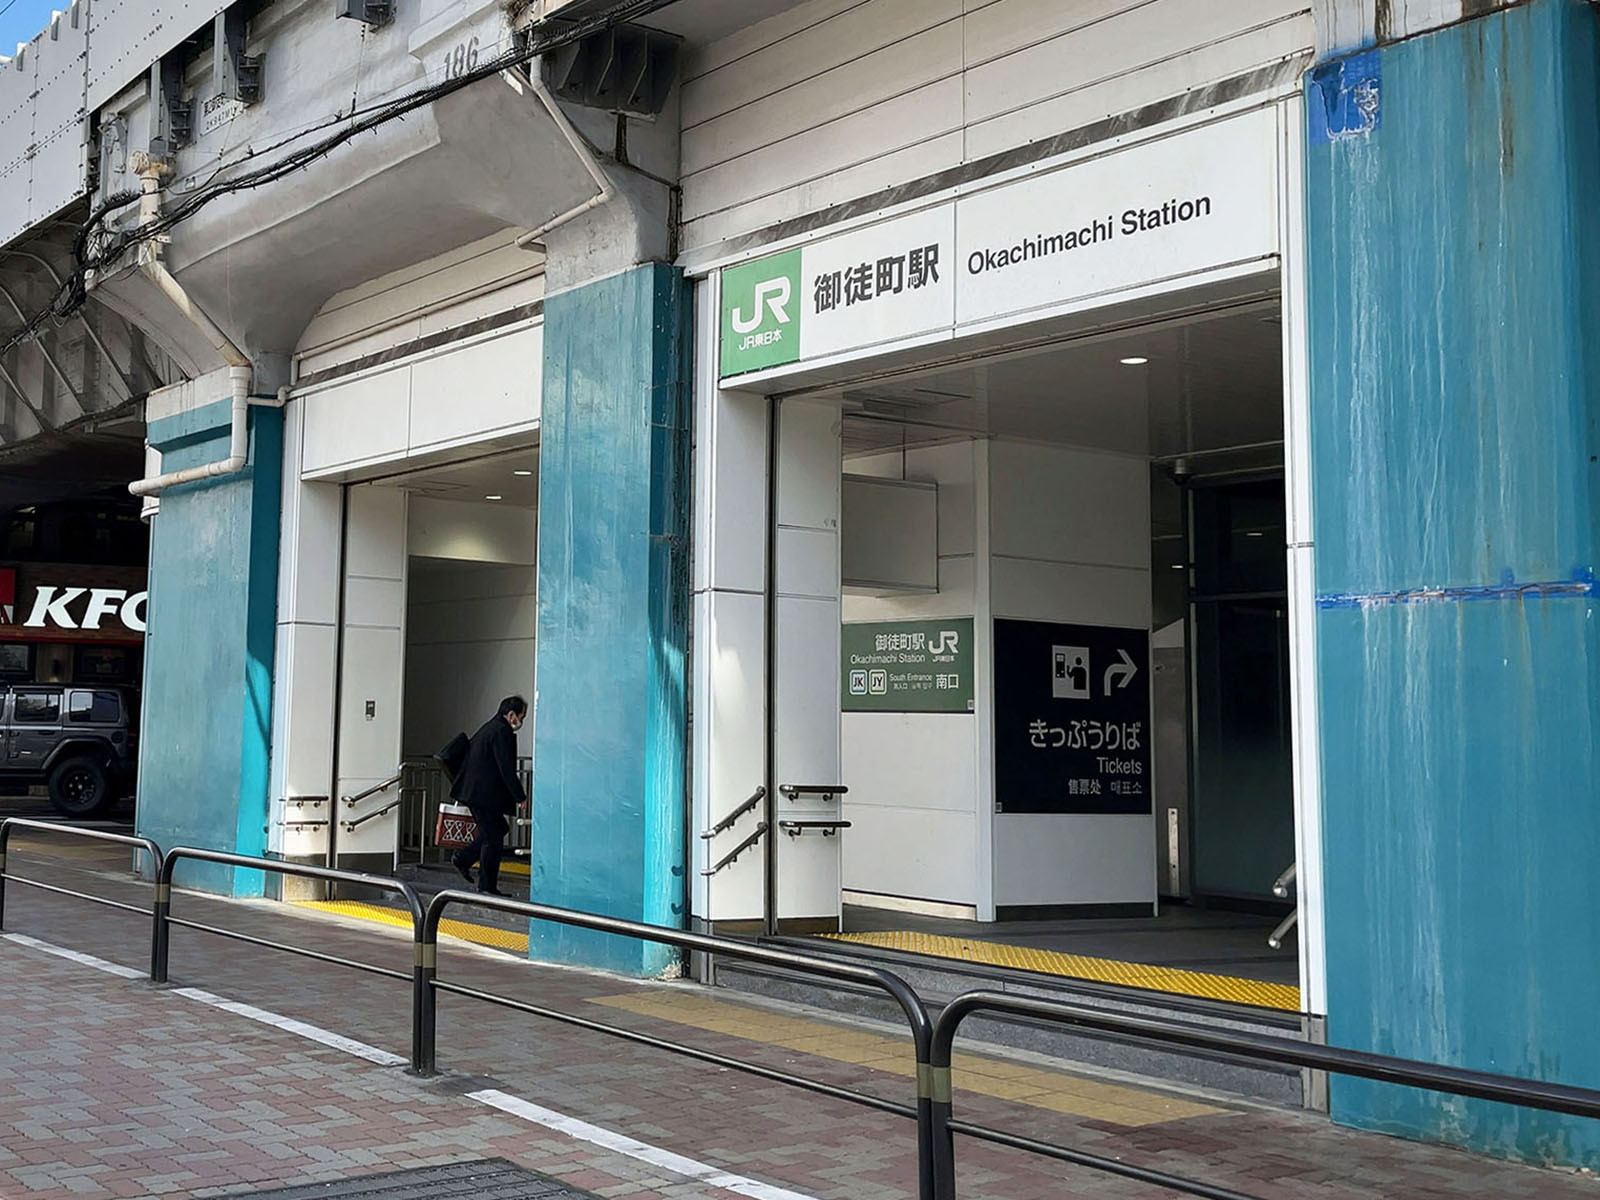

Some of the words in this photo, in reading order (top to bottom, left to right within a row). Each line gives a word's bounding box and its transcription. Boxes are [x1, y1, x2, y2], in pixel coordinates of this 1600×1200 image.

[443, 36, 480, 80] 186
[967, 215, 1113, 275] Okachimachi
[1120, 196, 1211, 235] Station
[813, 243, 940, 314] 御徒町駅
[731, 276, 791, 334] JR
[738, 327, 783, 351] JR東日本
[875, 632, 926, 652] 御徒町駅
[928, 630, 959, 654] JR
[850, 654, 898, 664] Okachimachi
[898, 653, 926, 663] Station
[889, 673, 906, 681] South
[907, 673, 933, 681] Entrance
[935, 673, 959, 689] 南口
[1029, 719, 1141, 750] きっぷうりば
[1096, 756, 1142, 774] Tickets
